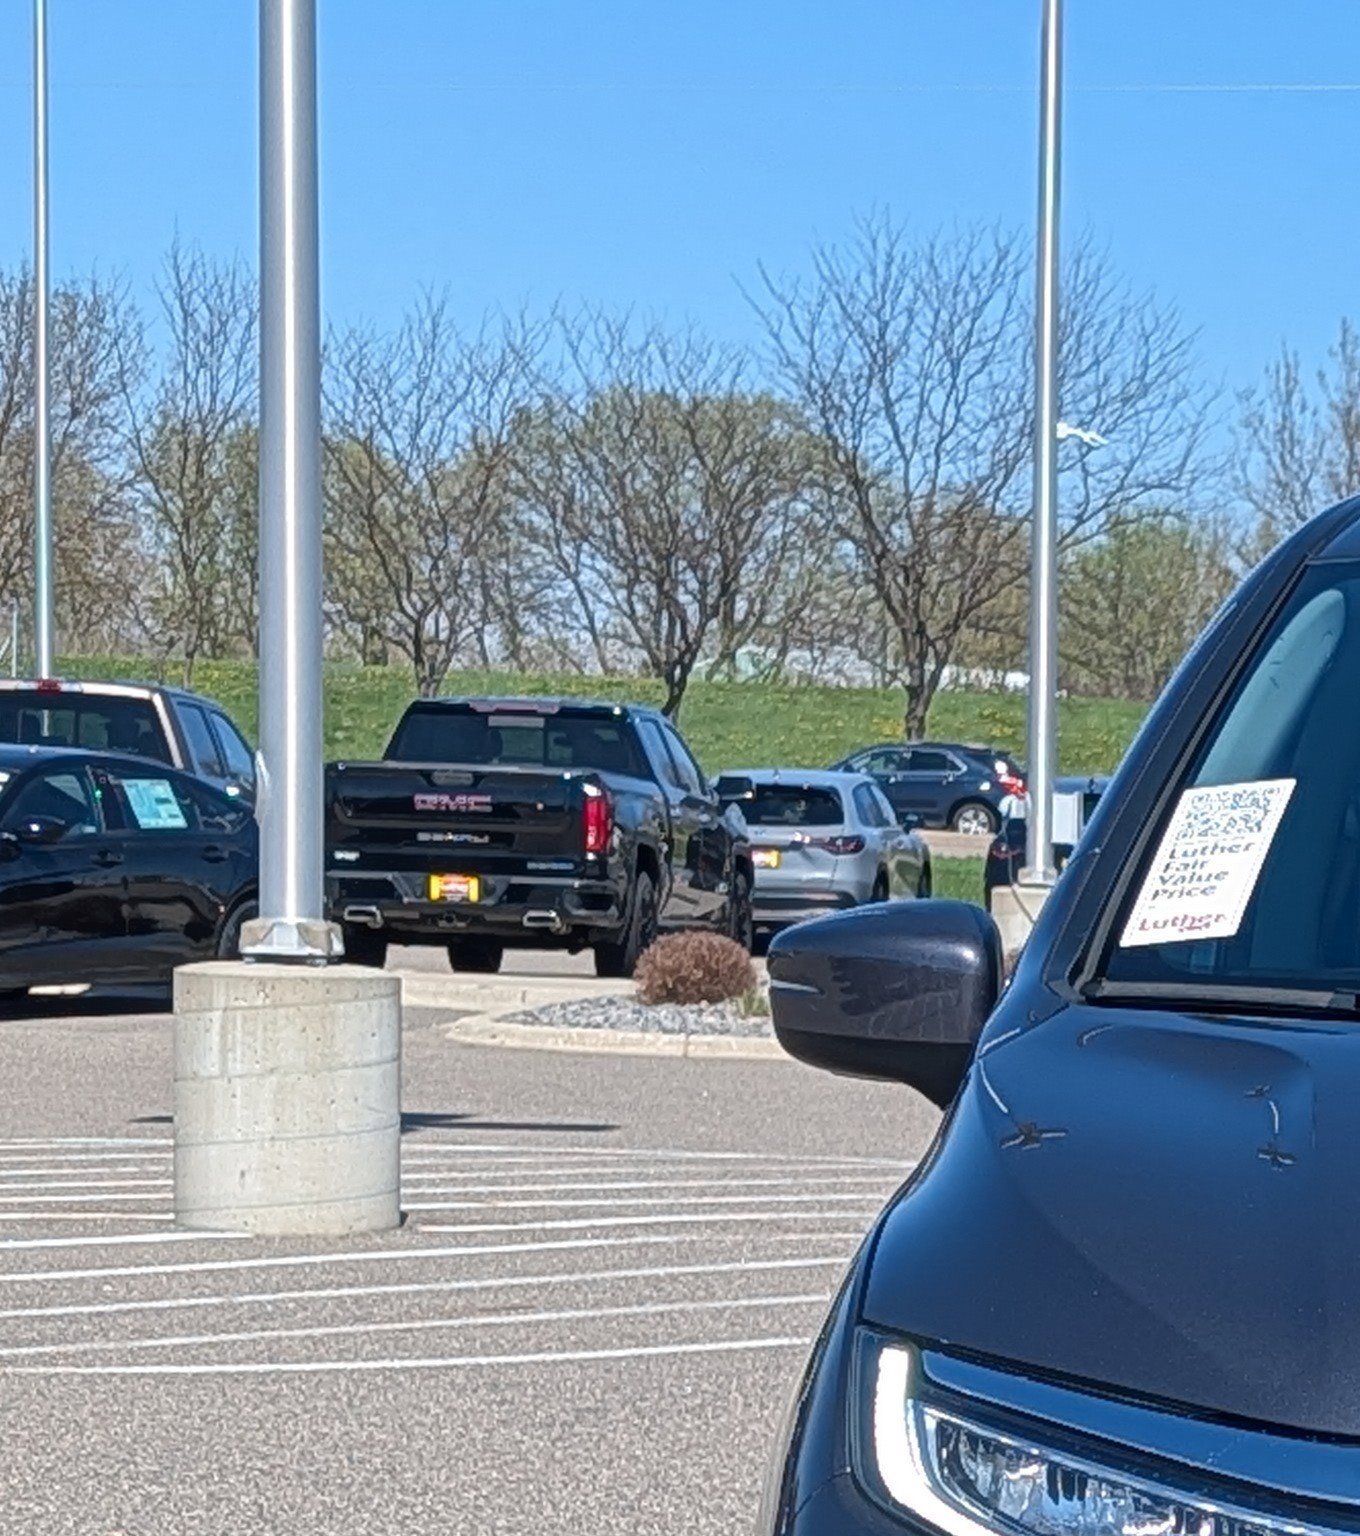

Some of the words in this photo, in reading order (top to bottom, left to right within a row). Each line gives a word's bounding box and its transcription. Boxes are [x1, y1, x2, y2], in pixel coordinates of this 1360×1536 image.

[1169, 842, 1255, 860] Luther
[1163, 859, 1208, 874] Fair
[1159, 871, 1229, 886] Value
